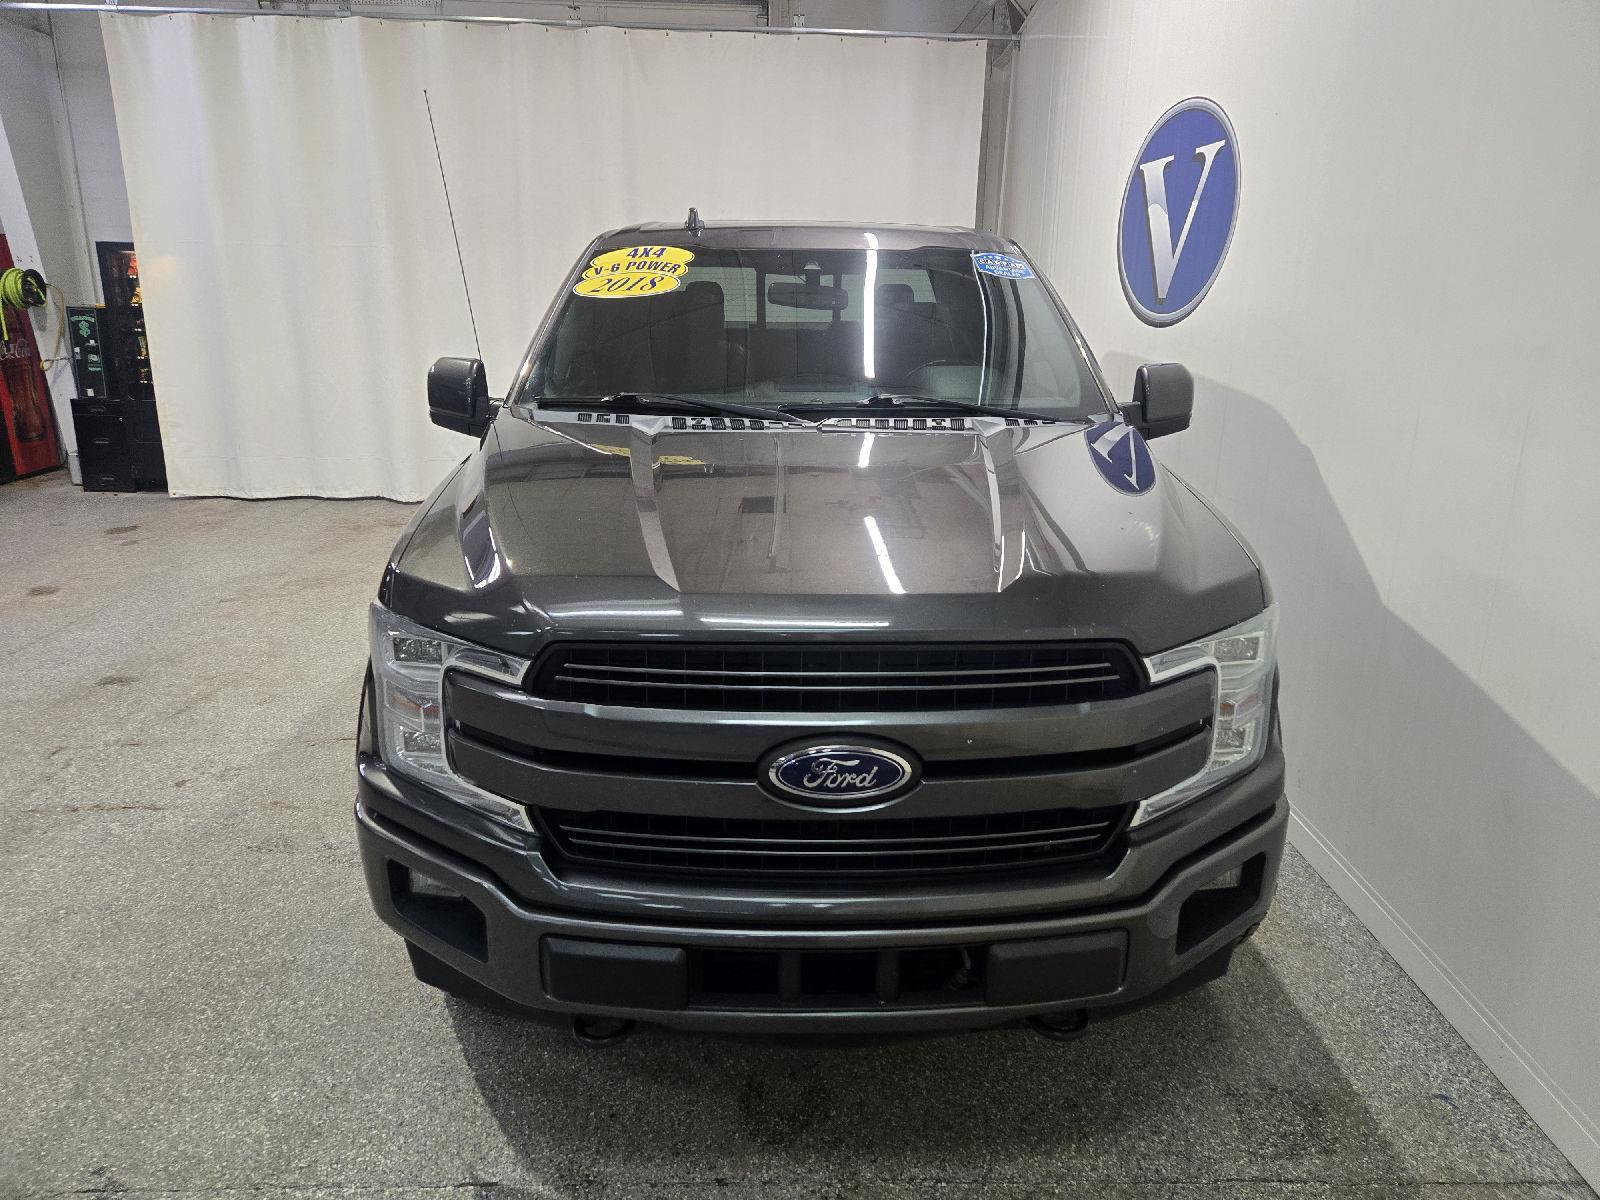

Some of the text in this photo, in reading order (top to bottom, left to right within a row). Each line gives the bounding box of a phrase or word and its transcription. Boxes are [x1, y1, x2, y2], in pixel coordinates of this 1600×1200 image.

[1139, 139, 1226, 299] V
[627, 247, 667, 258] 4X4
[625, 260, 681, 274] POWER
[589, 276, 665, 293] 2018
[803, 757, 879, 788] Ford
